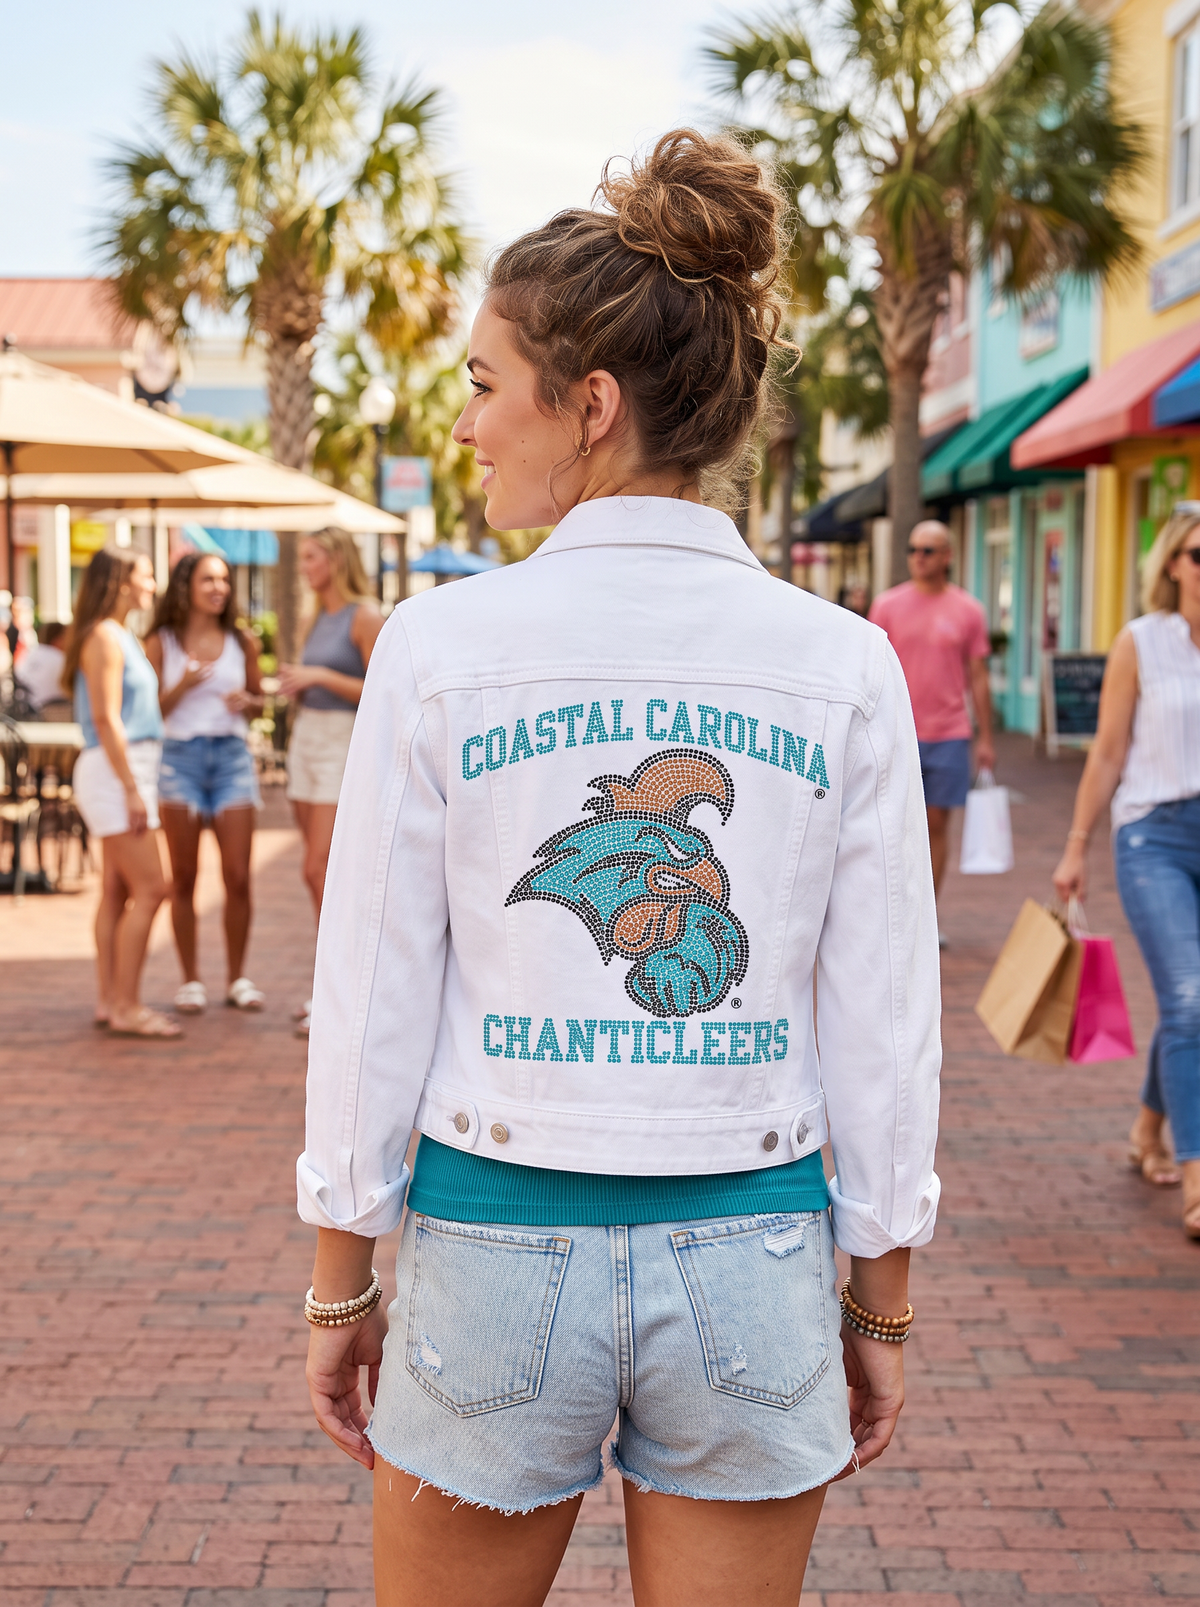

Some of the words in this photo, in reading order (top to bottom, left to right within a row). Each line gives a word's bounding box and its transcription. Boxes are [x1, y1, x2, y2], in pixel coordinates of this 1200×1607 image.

[462, 699, 634, 781] COASTAL
[646, 699, 831, 790] CAROLINA
[483, 1013, 789, 1066] CHANTICLEERS
